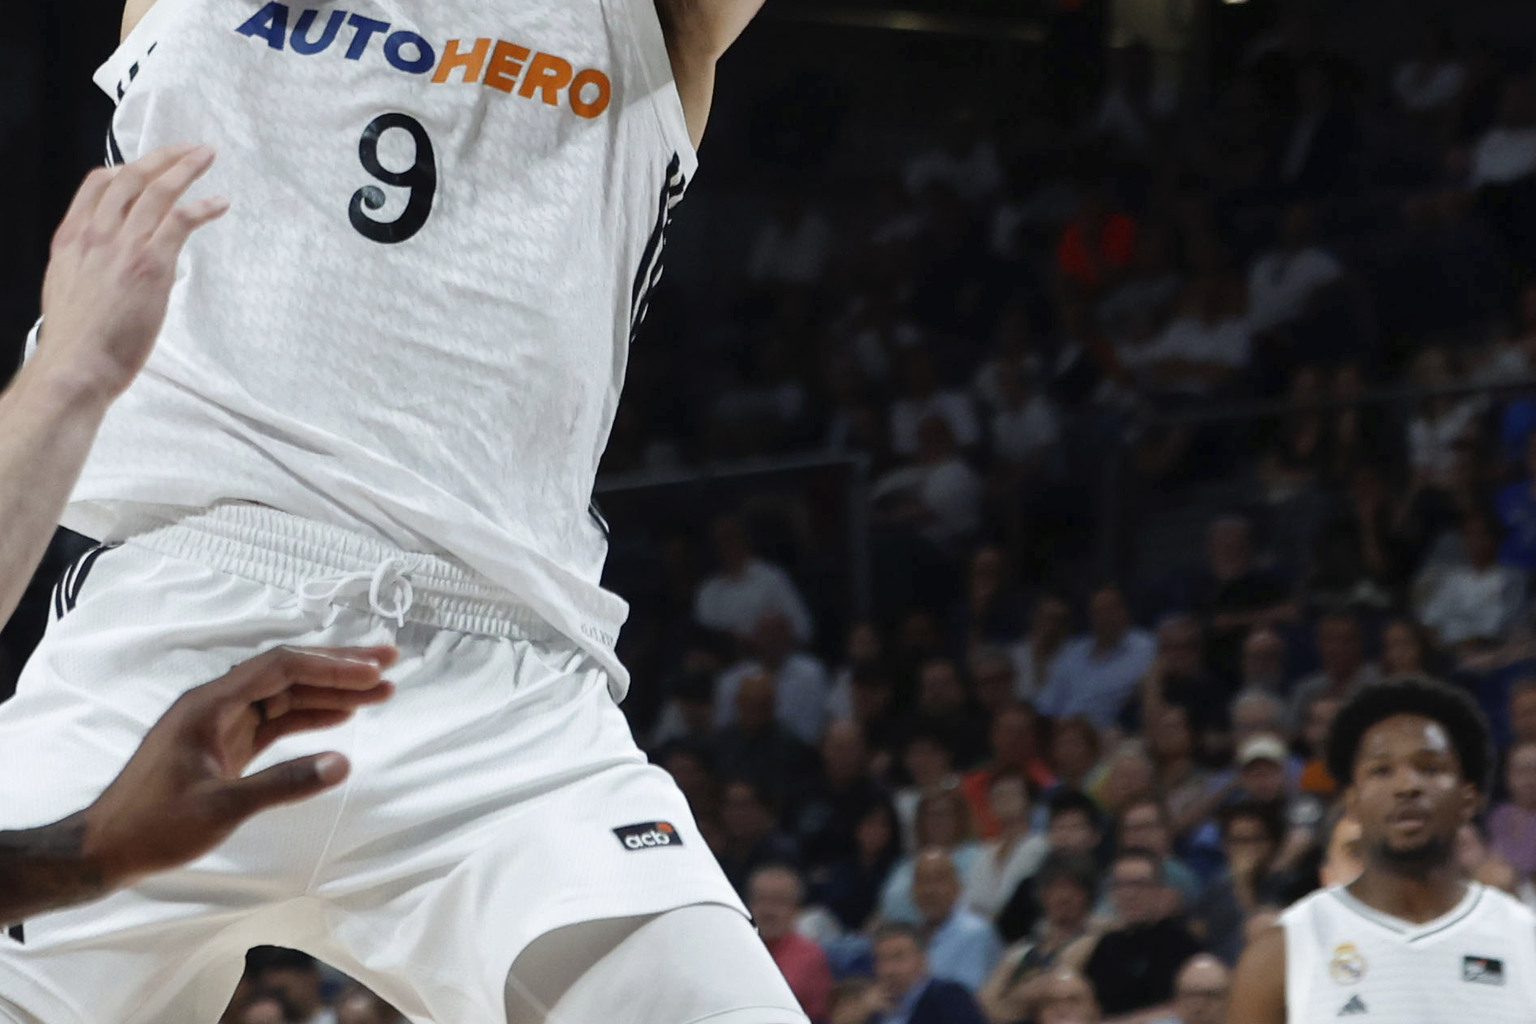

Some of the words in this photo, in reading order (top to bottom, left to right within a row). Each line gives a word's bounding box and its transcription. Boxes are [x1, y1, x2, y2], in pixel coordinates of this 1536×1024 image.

[235, 0, 611, 119] AUTOHERO
[348, 112, 437, 244] 9
[625, 830, 671, 849] acb
